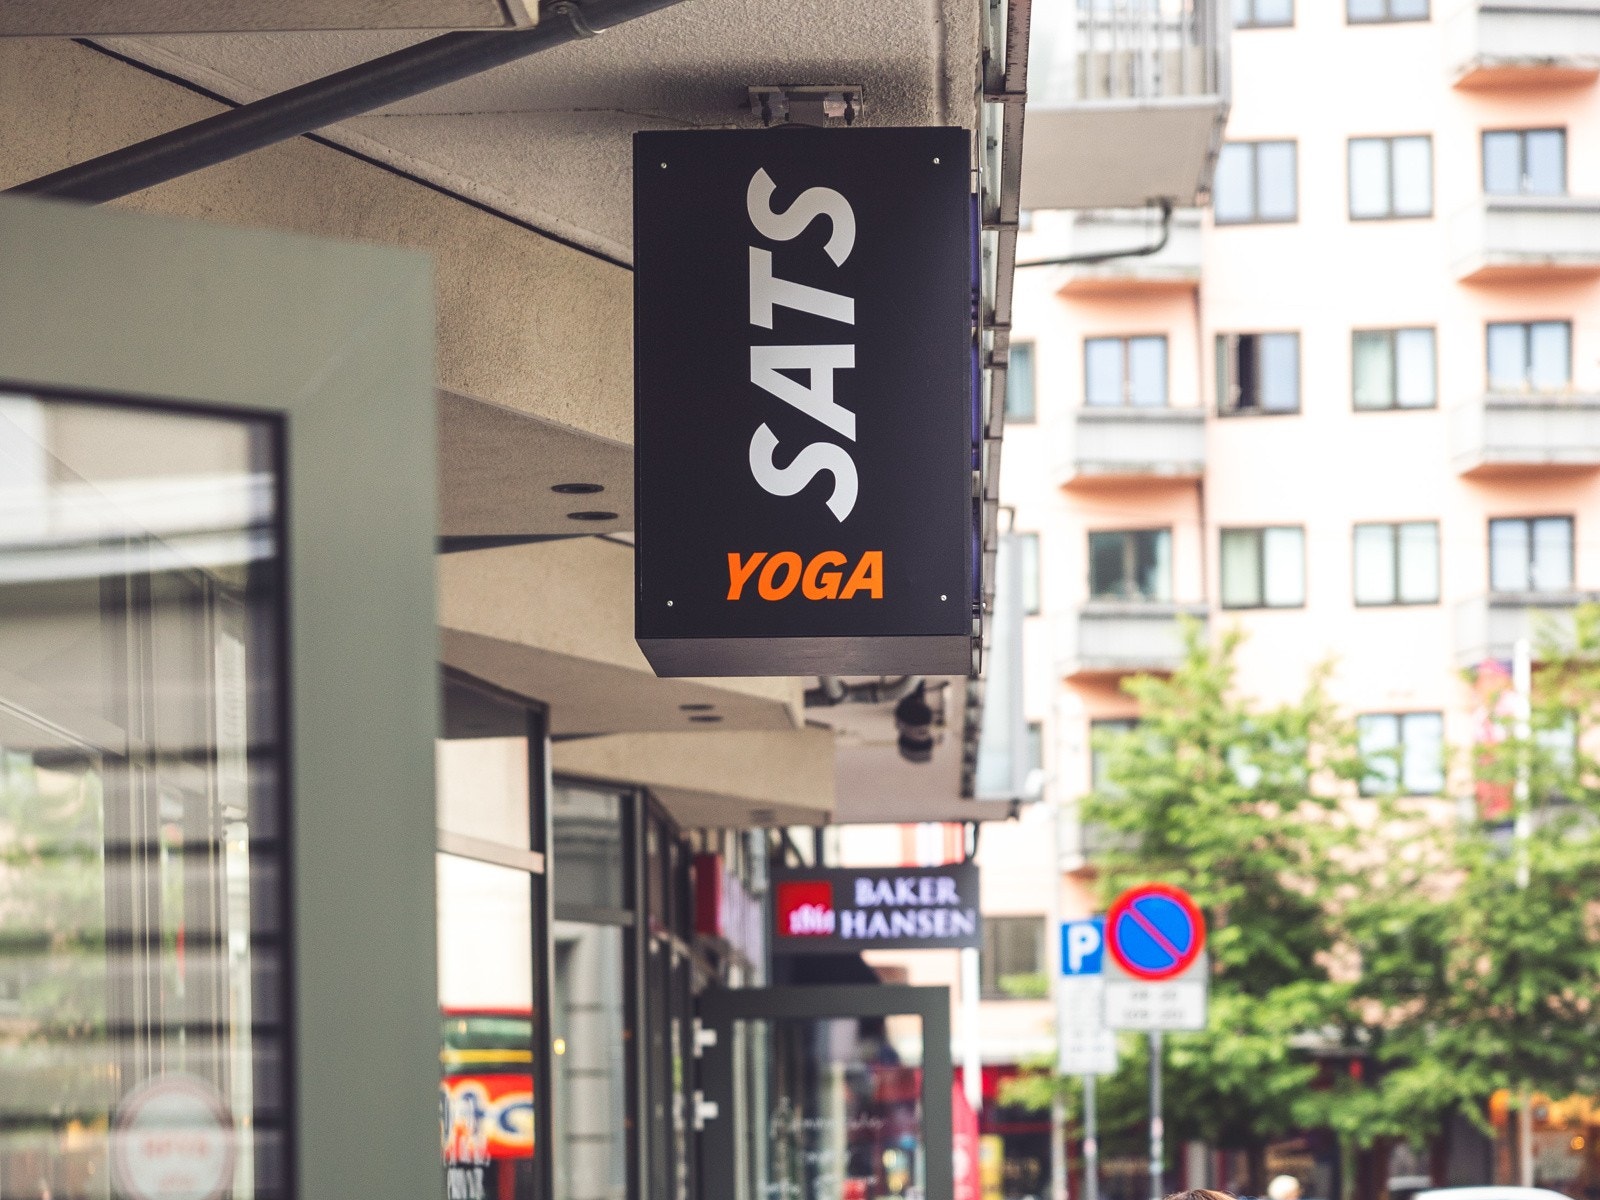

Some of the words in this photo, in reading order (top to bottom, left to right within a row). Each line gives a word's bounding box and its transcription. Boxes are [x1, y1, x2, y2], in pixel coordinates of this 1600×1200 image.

[746, 167, 859, 523] SATS
[726, 550, 884, 601] YOGA
[854, 877, 960, 906] BAKER
[840, 909, 976, 938] HANSEN
[1067, 923, 1101, 973] P
